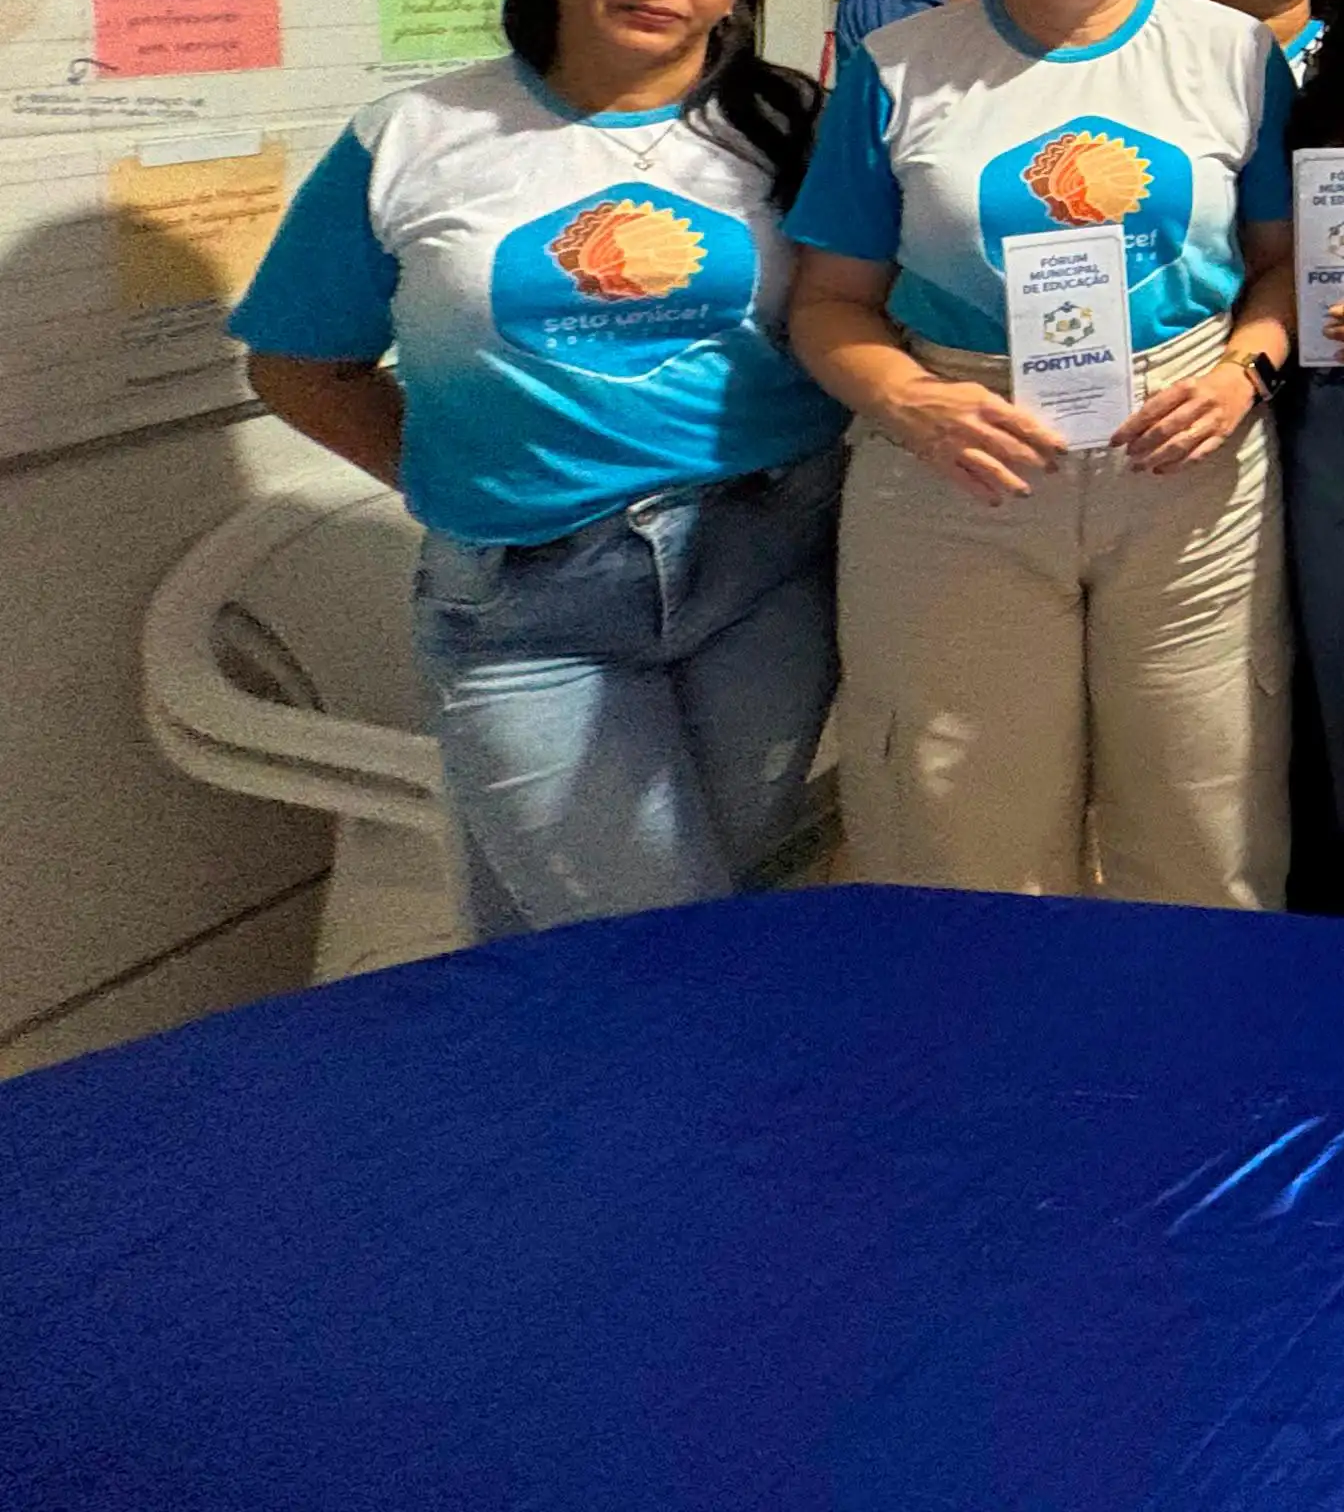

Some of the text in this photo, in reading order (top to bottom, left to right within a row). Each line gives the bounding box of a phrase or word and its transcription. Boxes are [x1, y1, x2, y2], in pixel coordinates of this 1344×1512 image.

[1312, 195, 1327, 206] DE
[1030, 265, 1101, 281] MUNICIPAL
[1023, 282, 1040, 295] DE
[544, 316, 609, 333] selo
[1023, 350, 1115, 375] FORTUNA
